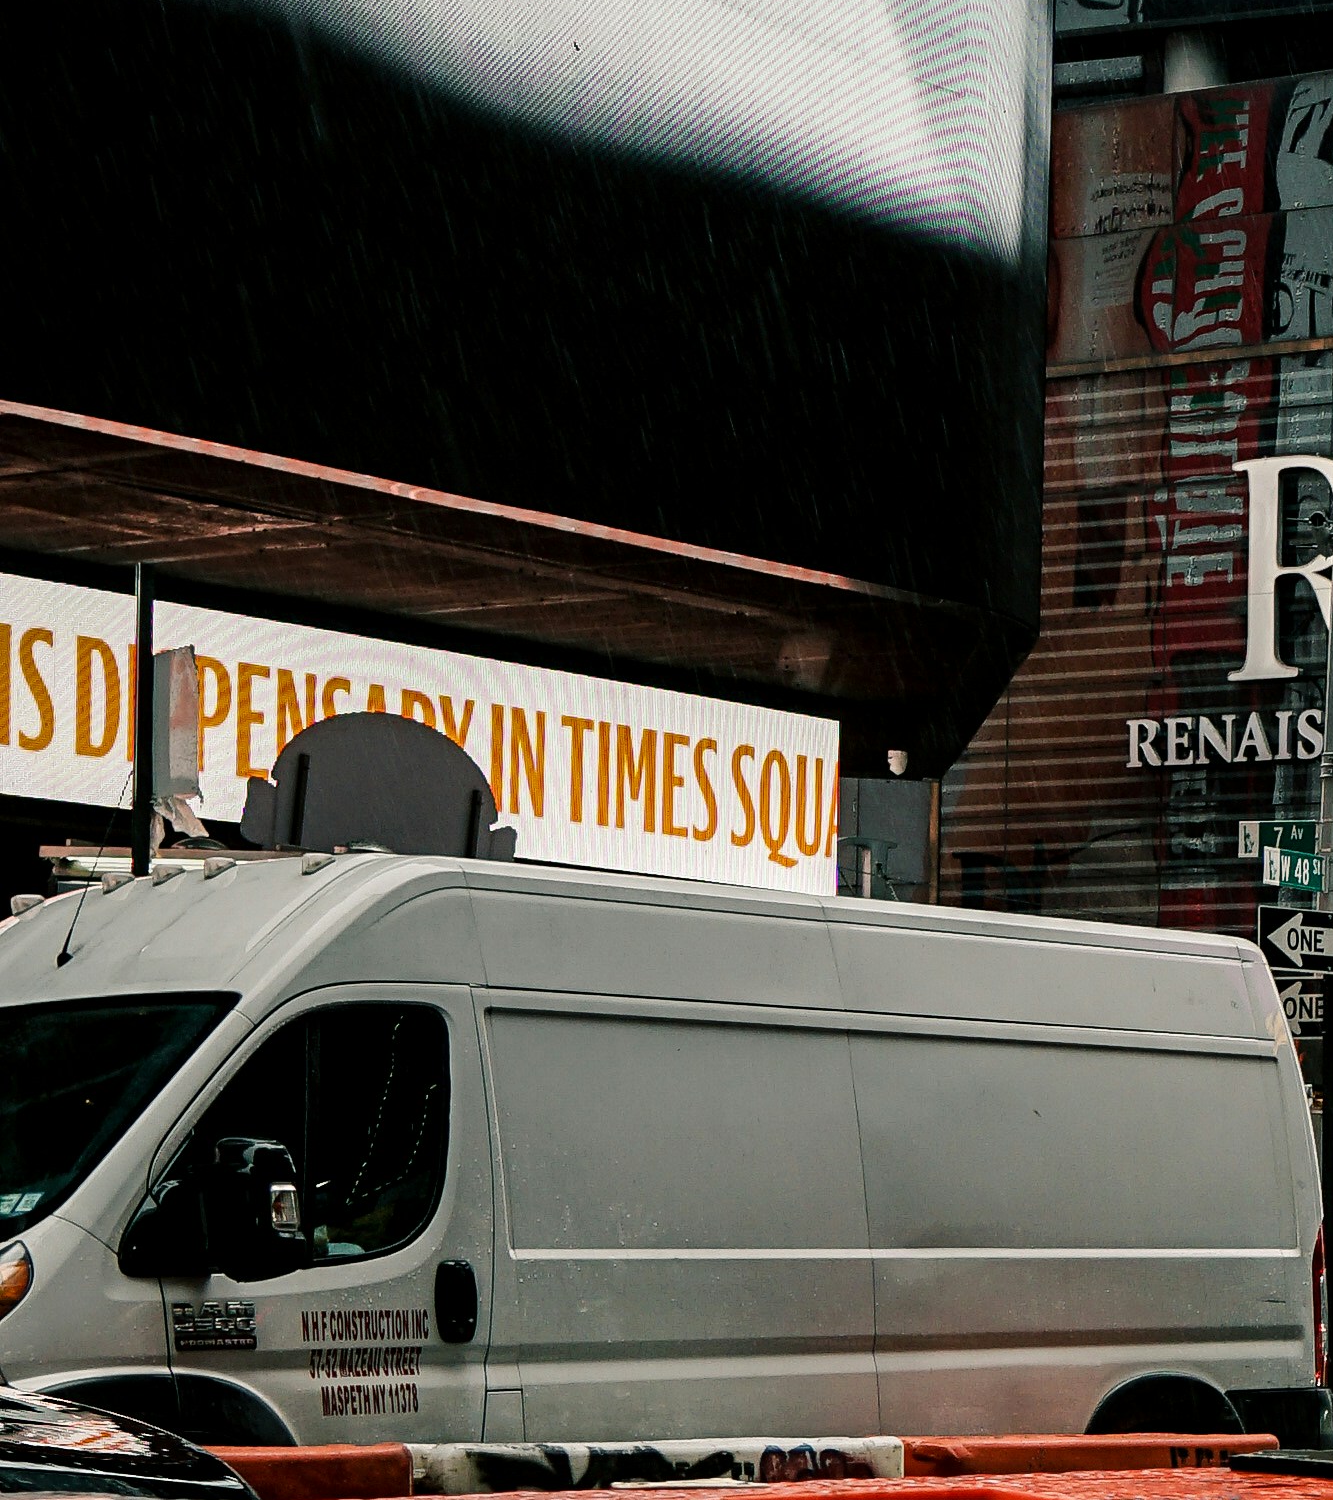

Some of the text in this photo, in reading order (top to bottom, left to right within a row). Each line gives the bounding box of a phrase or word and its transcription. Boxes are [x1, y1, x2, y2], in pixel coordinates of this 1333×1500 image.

[491, 703, 545, 818] IN
[562, 715, 718, 842] TIMES
[1273, 824, 1304, 848] 7 Av
[1281, 854, 1291, 882] W
[1294, 858, 1310, 886] 48
[1287, 927, 1325, 953] ONE
[1283, 996, 1324, 1020] ONE
[302, 1308, 430, 1342] N H F CONSTRUCTION INC
[309, 1348, 338, 1378] 57-52
[382, 1347, 423, 1376] STREET
[321, 1382, 419, 1417] MASPETH NY 11378
